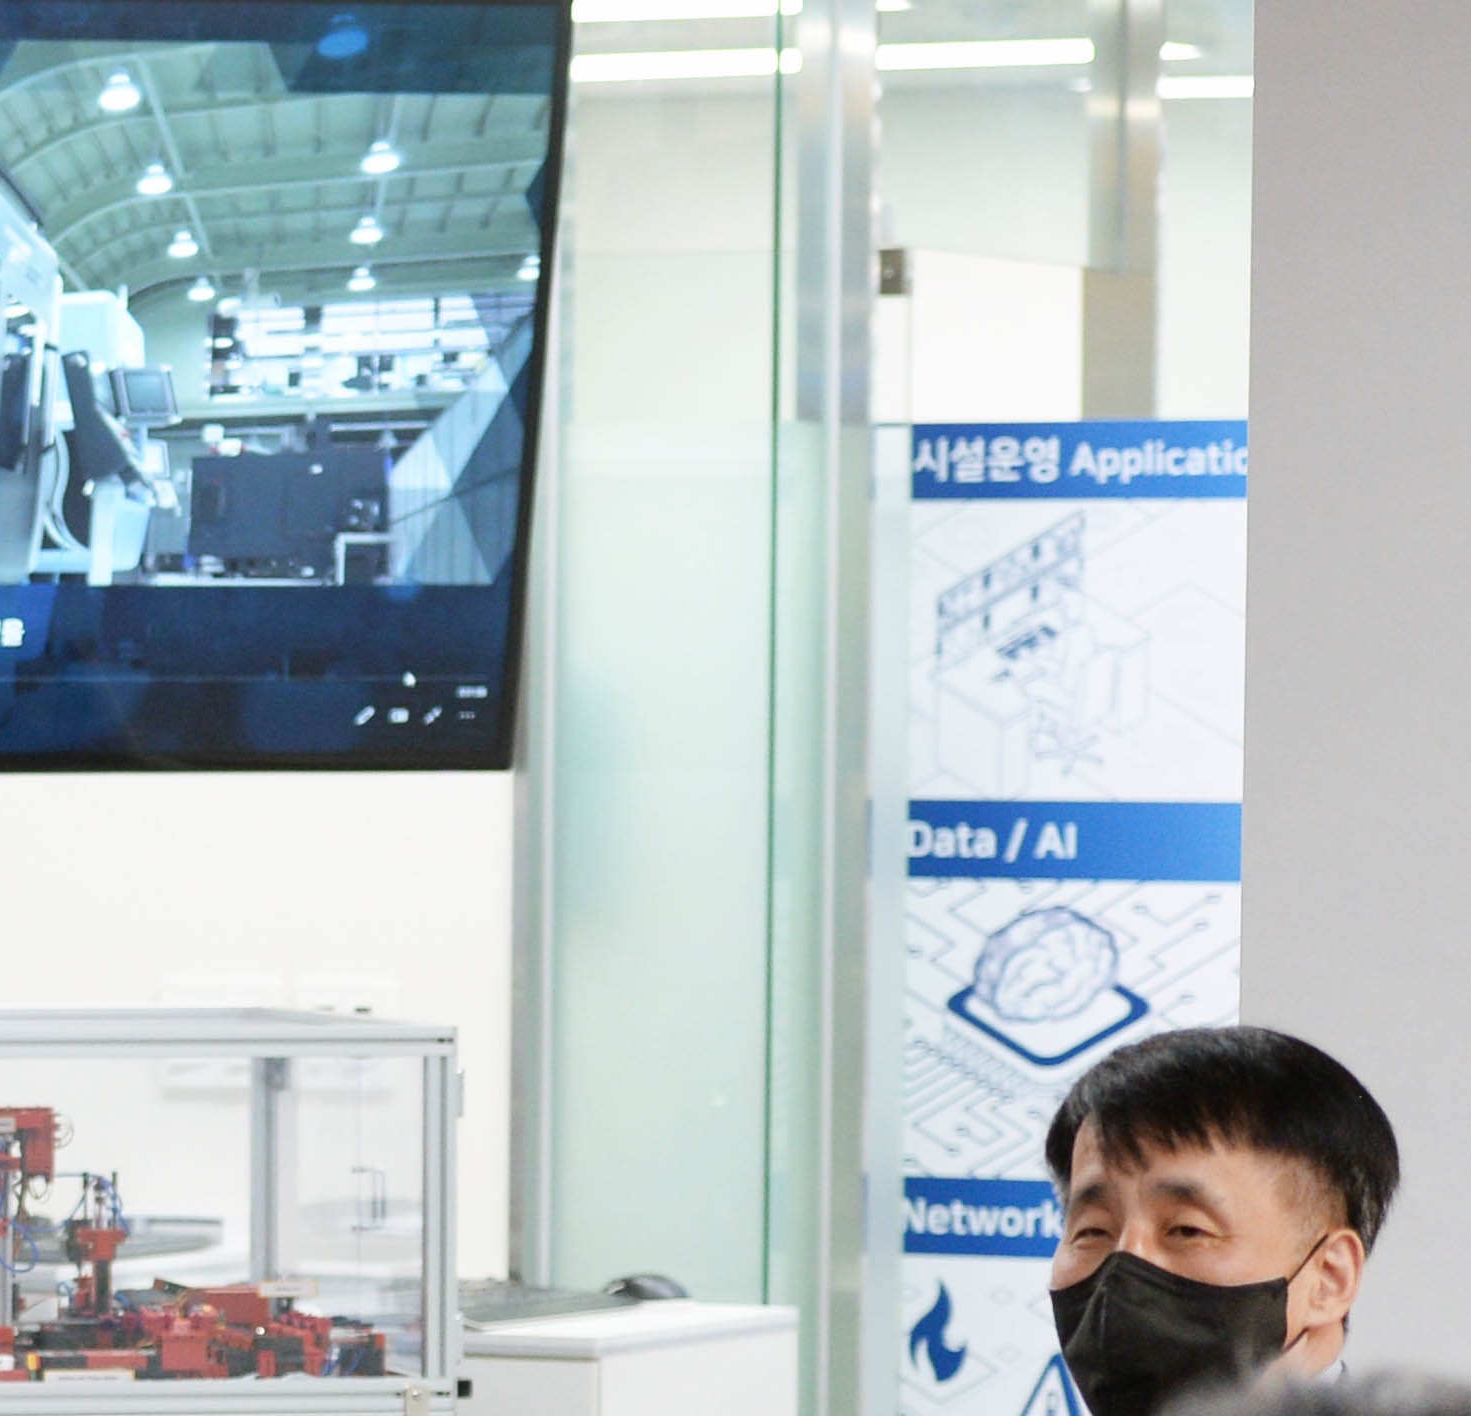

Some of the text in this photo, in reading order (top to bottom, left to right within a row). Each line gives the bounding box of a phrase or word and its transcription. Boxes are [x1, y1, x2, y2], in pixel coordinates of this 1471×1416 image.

[913, 433, 1060, 485] 시설운영
[908, 818, 997, 861] Data
[1033, 820, 1079, 861] AI
[900, 1195, 1064, 1239] Network
